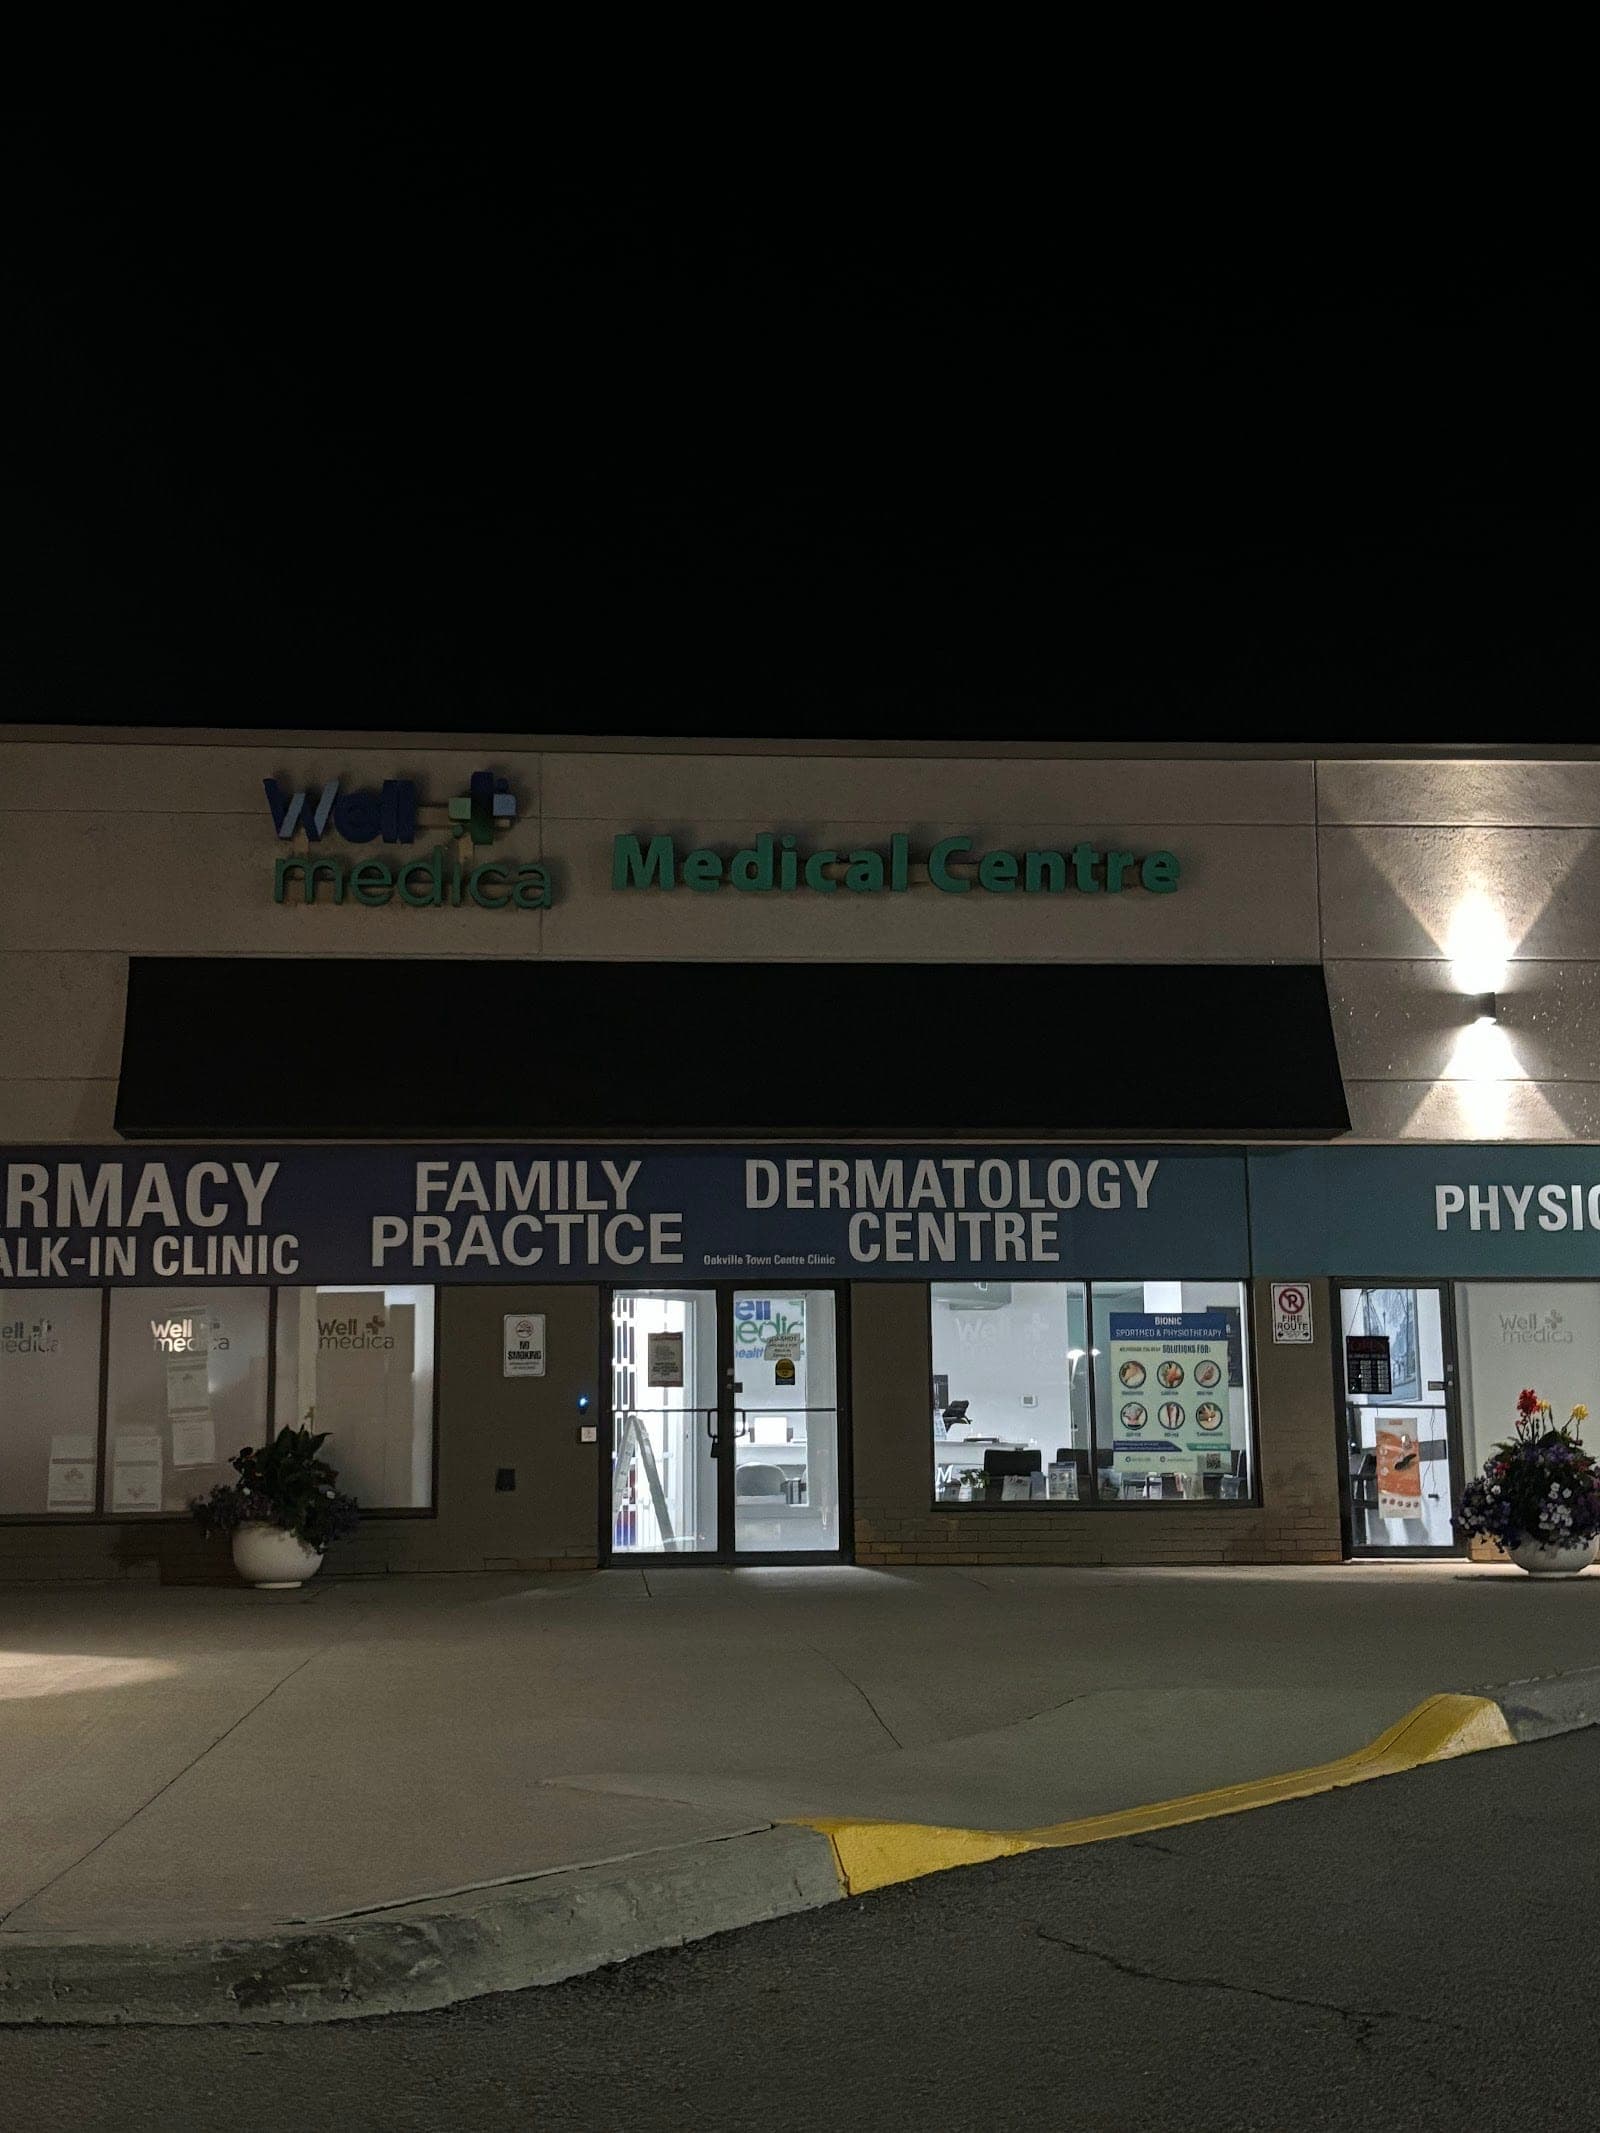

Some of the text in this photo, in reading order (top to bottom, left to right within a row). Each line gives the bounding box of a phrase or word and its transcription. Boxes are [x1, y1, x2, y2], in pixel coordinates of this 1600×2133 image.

[263, 778, 416, 844] Well
[611, 832, 1182, 893] Medical Centre
[275, 844, 552, 909] medica
[415, 1159, 643, 1212] FAMILY
[744, 1158, 1159, 1210] DERMATOLOGY
[6, 1161, 280, 1228] RMACY
[371, 1213, 684, 1268] PRACTICE
[848, 1211, 1060, 1264] CENTRE
[152, 1233, 299, 1277] CLINIC
[703, 1254, 836, 1265] Oakville Town Centre Clinic
[317, 1318, 357, 1336] Well
[1154, 1316, 1182, 1326] BIONIC
[1278, 1322, 1308, 1331] ROUTE
[1282, 1314, 1303, 1323] FIRE
[1499, 1312, 1537, 1330] Well
[151, 1319, 193, 1339] Well
[1163, 1328, 1222, 1337] PHYSIOTHERAPY
[1502, 1327, 1573, 1344] medica
[0, 1334, 58, 1353] edica
[154, 1337, 230, 1352] mea
[319, 1332, 395, 1350] medica
[519, 1341, 530, 1350] NO
[1162, 1344, 1195, 1354] SOLUTIONS
[507, 1350, 541, 1360] SMOKING
